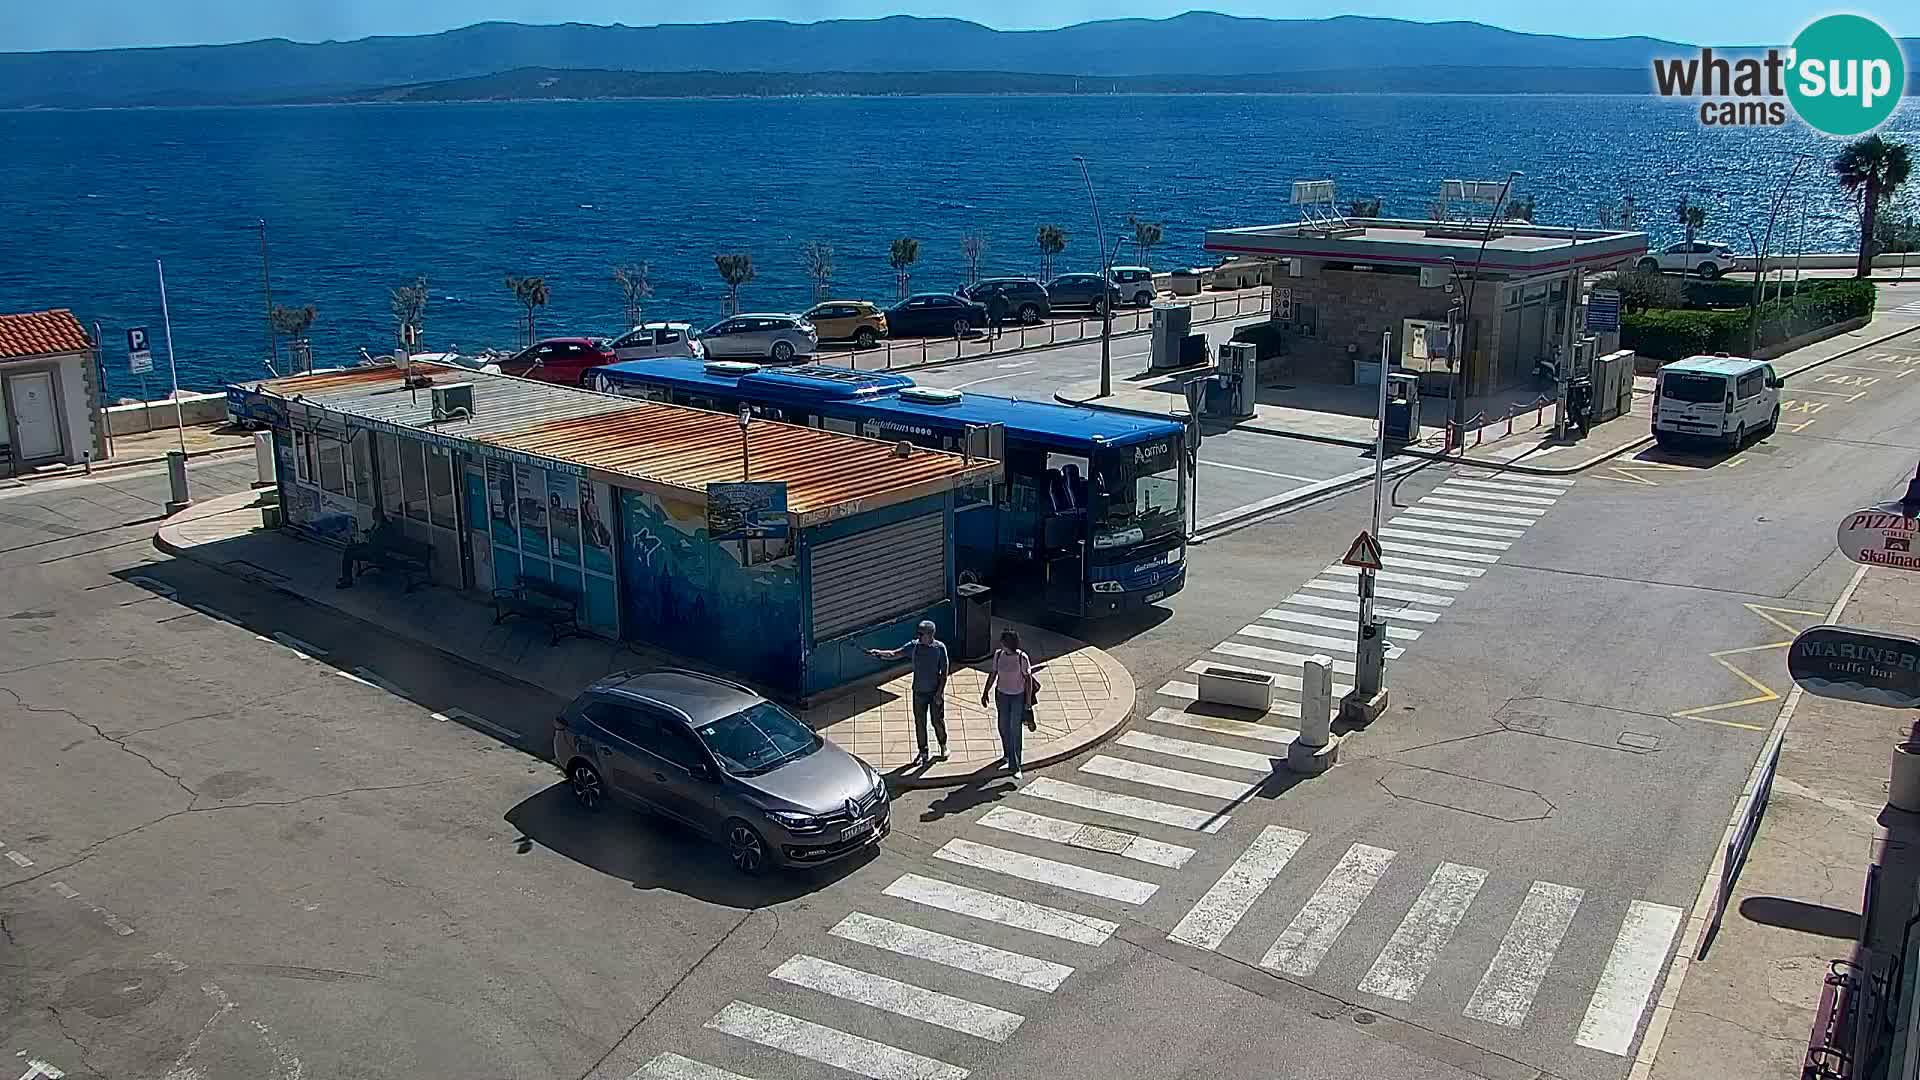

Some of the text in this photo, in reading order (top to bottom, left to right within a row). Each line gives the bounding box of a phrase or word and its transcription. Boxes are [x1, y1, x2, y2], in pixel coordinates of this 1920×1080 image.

[132, 330, 145, 349] P
[1815, 374, 1881, 388] TAXI
[1780, 400, 1830, 414] AXI
[1144, 443, 1168, 458] arriva
[495, 448, 527, 463] STATION
[529, 456, 554, 470] TICKET
[556, 462, 582, 476] OFFICE
[1849, 515, 1920, 531] PIZZE
[1801, 641, 1920, 671] MARINER
[1829, 661, 1897, 680] caffe bar
